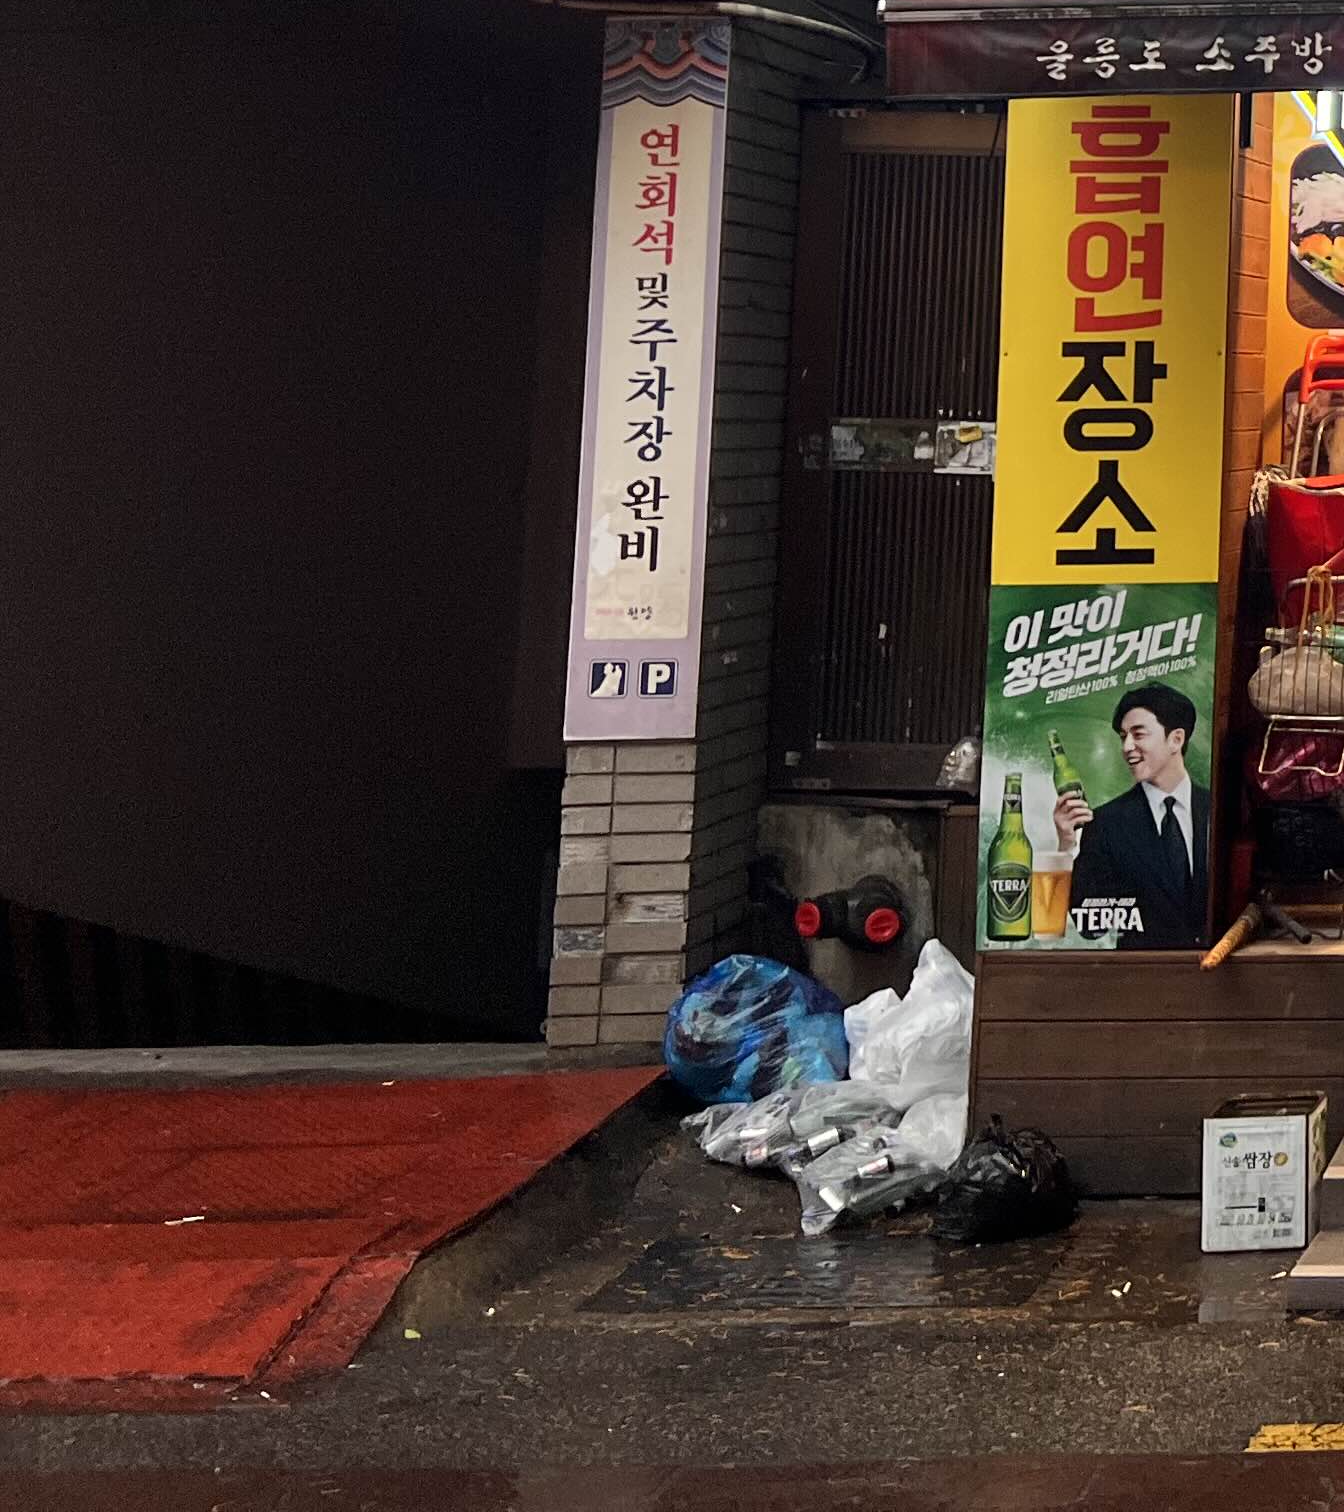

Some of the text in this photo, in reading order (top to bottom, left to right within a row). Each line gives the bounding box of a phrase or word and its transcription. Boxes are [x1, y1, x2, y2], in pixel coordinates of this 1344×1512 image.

[1036, 31, 1333, 80] 울릉도 소주방
[633, 123, 681, 265] 연회석
[1056, 104, 1171, 567] 흡연장소
[618, 478, 670, 572] 완비
[1003, 589, 1128, 654] 이 맛이
[647, 663, 671, 694] P
[1003, 613, 1203, 699] 청정라거다!
[991, 878, 1027, 894] TERRA
[1072, 907, 1145, 934] TERRA
